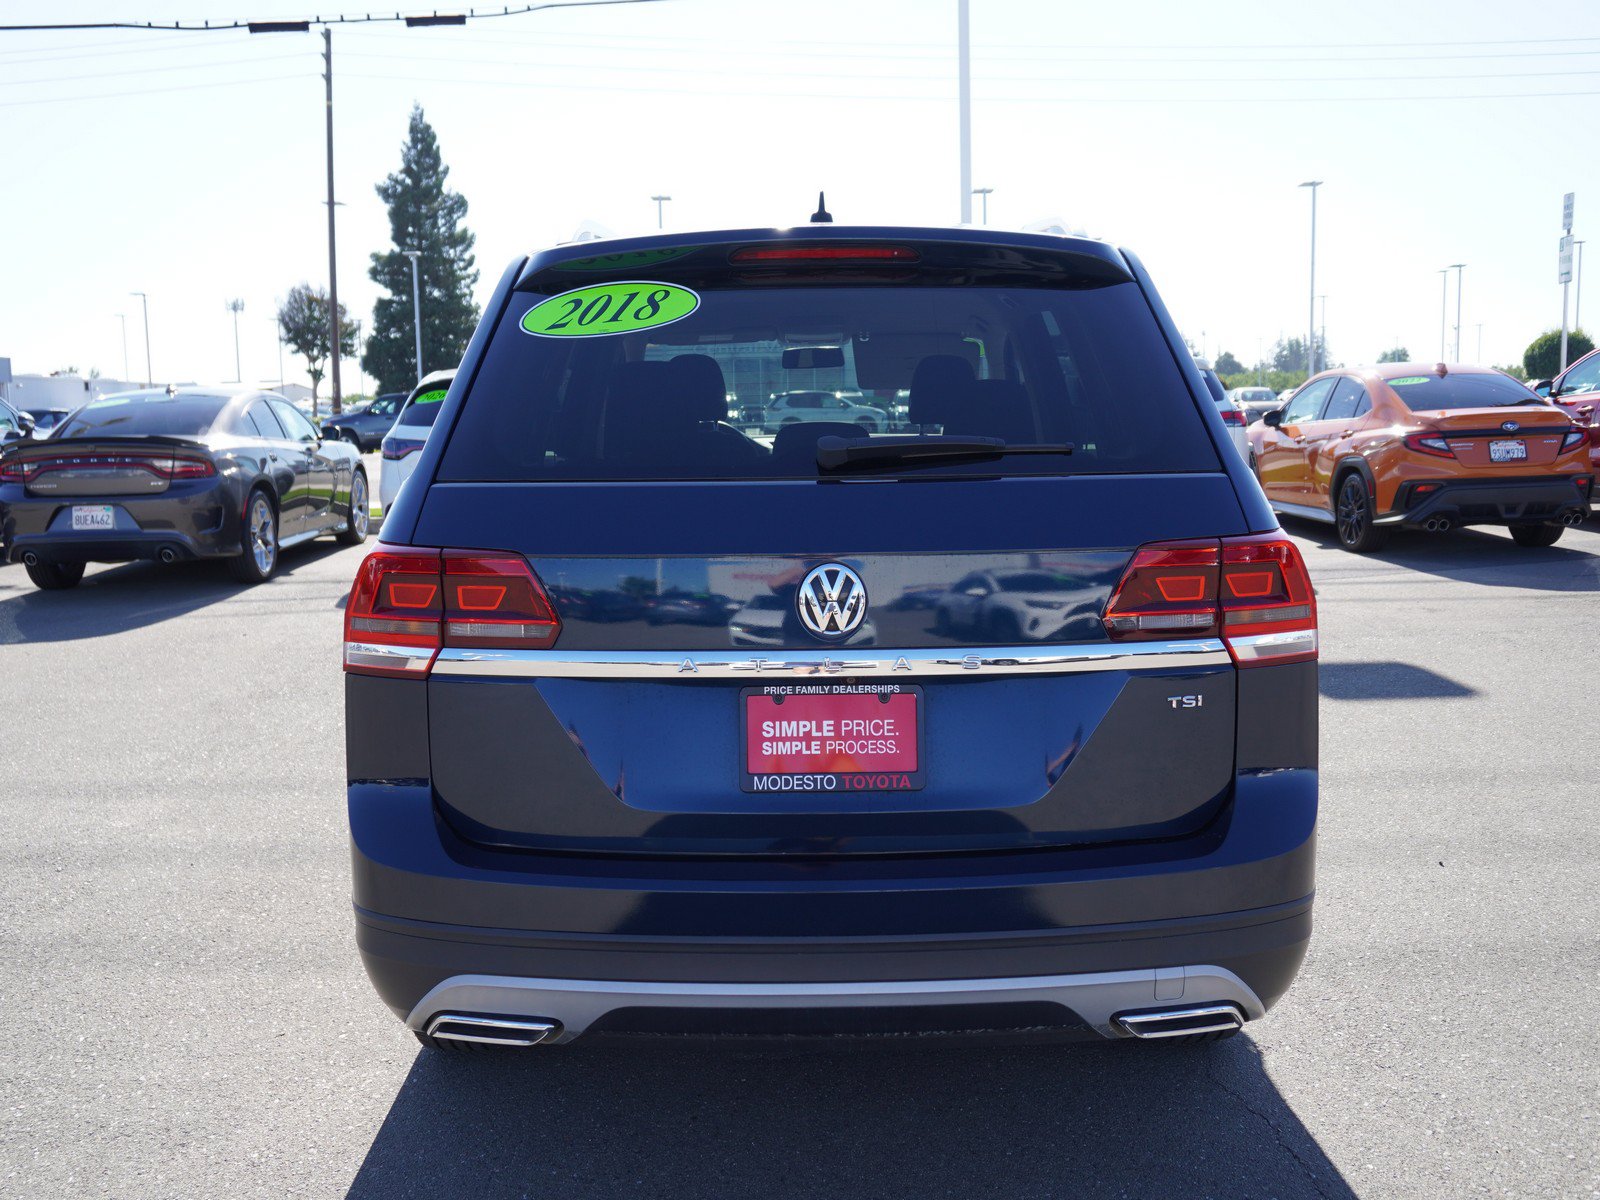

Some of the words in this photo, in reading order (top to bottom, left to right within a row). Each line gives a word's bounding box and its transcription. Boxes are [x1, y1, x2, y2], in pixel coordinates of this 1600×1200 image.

[545, 289, 671, 331] 2018
[74, 514, 111, 526] 8UEA462
[678, 653, 982, 673] ATLAS
[764, 686, 793, 695] PRICE
[795, 685, 830, 694] FAMILY
[832, 684, 900, 694] DEALERSHIPS
[1167, 694, 1203, 708] TSI
[762, 720, 835, 738] SIMPLE
[841, 719, 900, 736] PRICE.
[762, 741, 821, 755] SIMPLE
[826, 740, 900, 755] PROCESS.
[753, 775, 837, 790] MODESTO
[841, 774, 912, 789] TOYOTA
